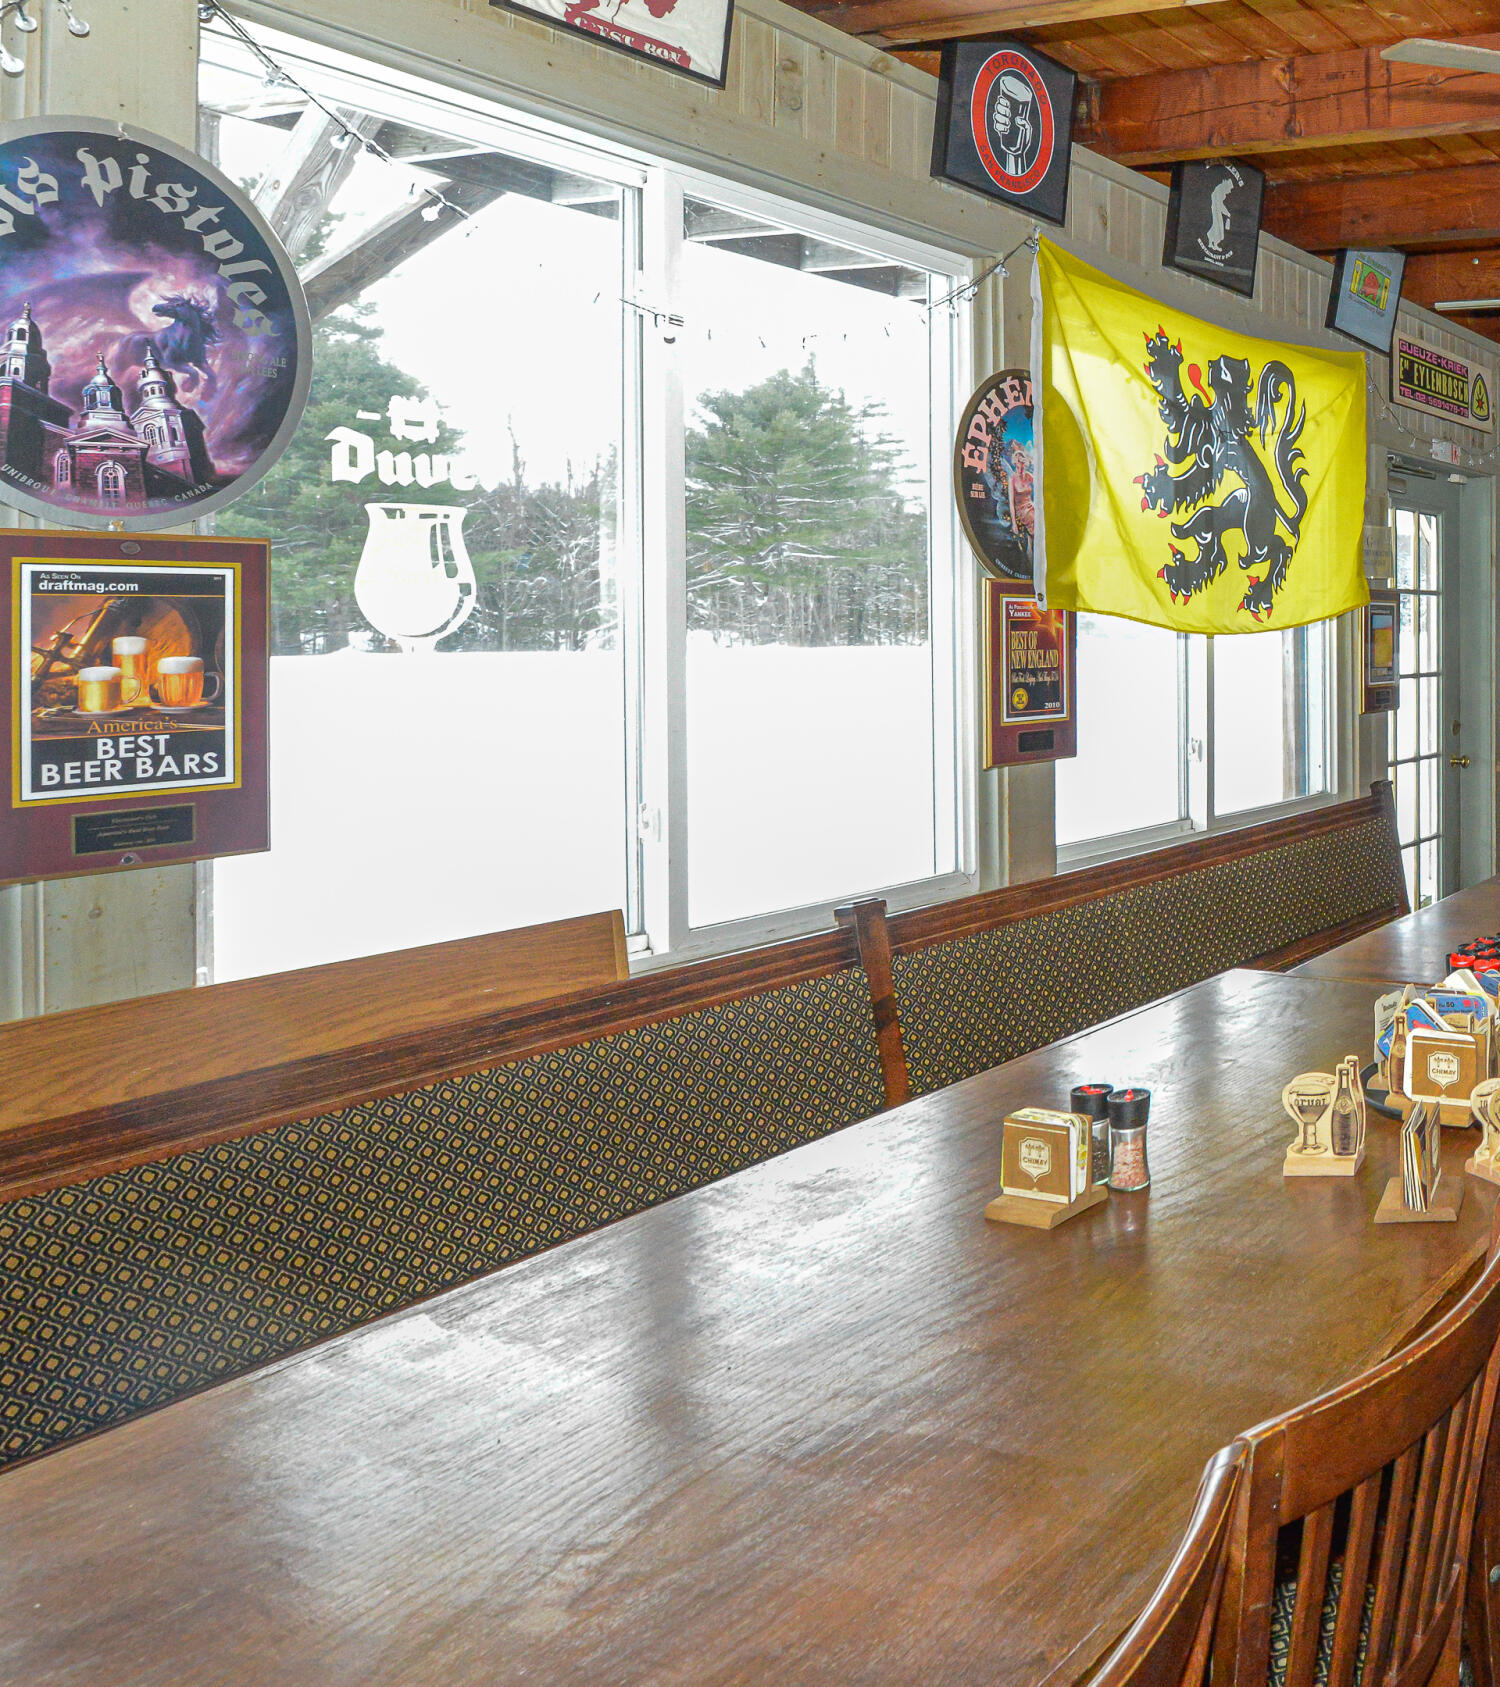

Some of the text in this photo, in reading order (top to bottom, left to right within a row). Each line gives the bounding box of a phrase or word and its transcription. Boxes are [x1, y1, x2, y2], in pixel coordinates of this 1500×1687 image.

[994, 169, 1041, 190] FRANCISCO
[1413, 362, 1469, 403] EYLENBOSCH
[324, 426, 500, 493] Duve
[174, 482, 214, 503] CANADA
[38, 579, 139, 593] draftmag.com
[1009, 609, 1032, 618] YANKEE
[1011, 630, 1038, 650] BEST OF
[1010, 649, 1059, 669] NEW ENGLAND
[1044, 701, 1061, 709] 2010
[87, 716, 178, 735] America's
[97, 734, 171, 760] BEST
[40, 752, 219, 786] BEER BARS
[1431, 1067, 1457, 1076] CHIMAY
[1022, 1156, 1048, 1166] CHIMAY
